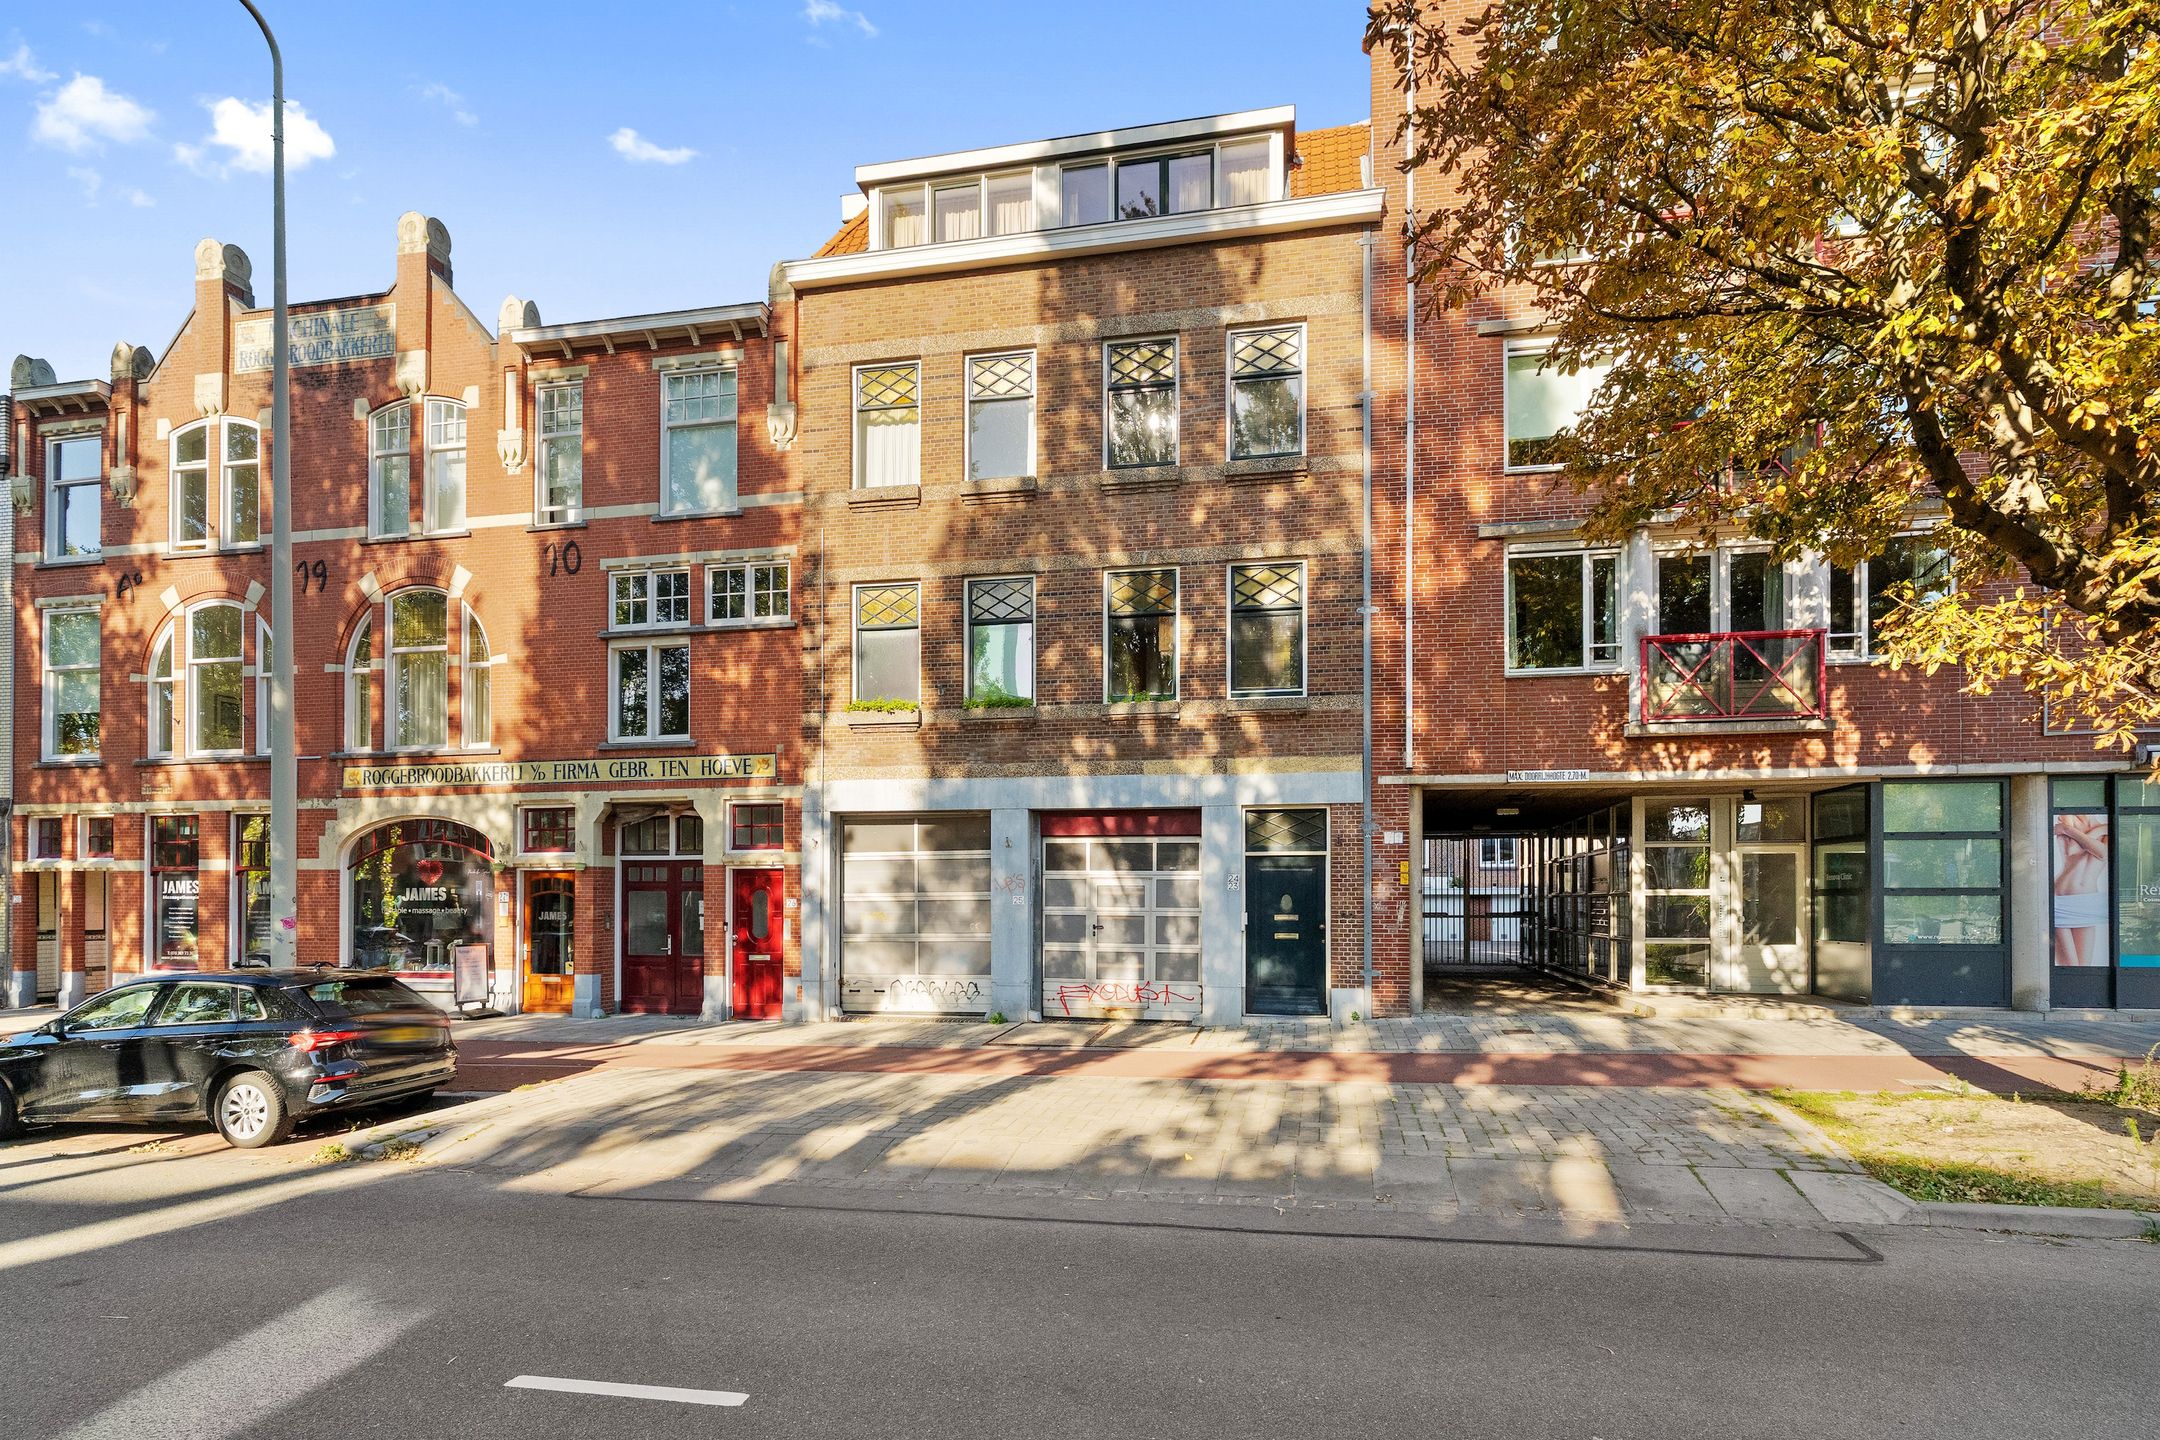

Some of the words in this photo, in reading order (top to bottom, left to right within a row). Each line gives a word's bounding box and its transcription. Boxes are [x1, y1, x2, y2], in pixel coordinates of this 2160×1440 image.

[269, 312, 359, 341] CHINALE
[295, 559, 328, 594] 19
[543, 539, 582, 577] 10
[362, 764, 523, 785] ROGGEBROODBAKKERIJ
[553, 762, 600, 780] FIRMA
[609, 760, 654, 779] GEBR.
[659, 759, 690, 777] TEN
[701, 758, 753, 776] HOEVE
[1227, 874, 1239, 882] 24
[162, 879, 200, 895] JAMES
[1228, 882, 1239, 891] 23
[2140, 884, 2160, 895] Re
[402, 886, 447, 902] JAMES
[1013, 896, 1024, 905] 25
[411, 907, 441, 915] massage
[444, 906, 468, 915] beauty
[538, 911, 567, 921] JAMES
